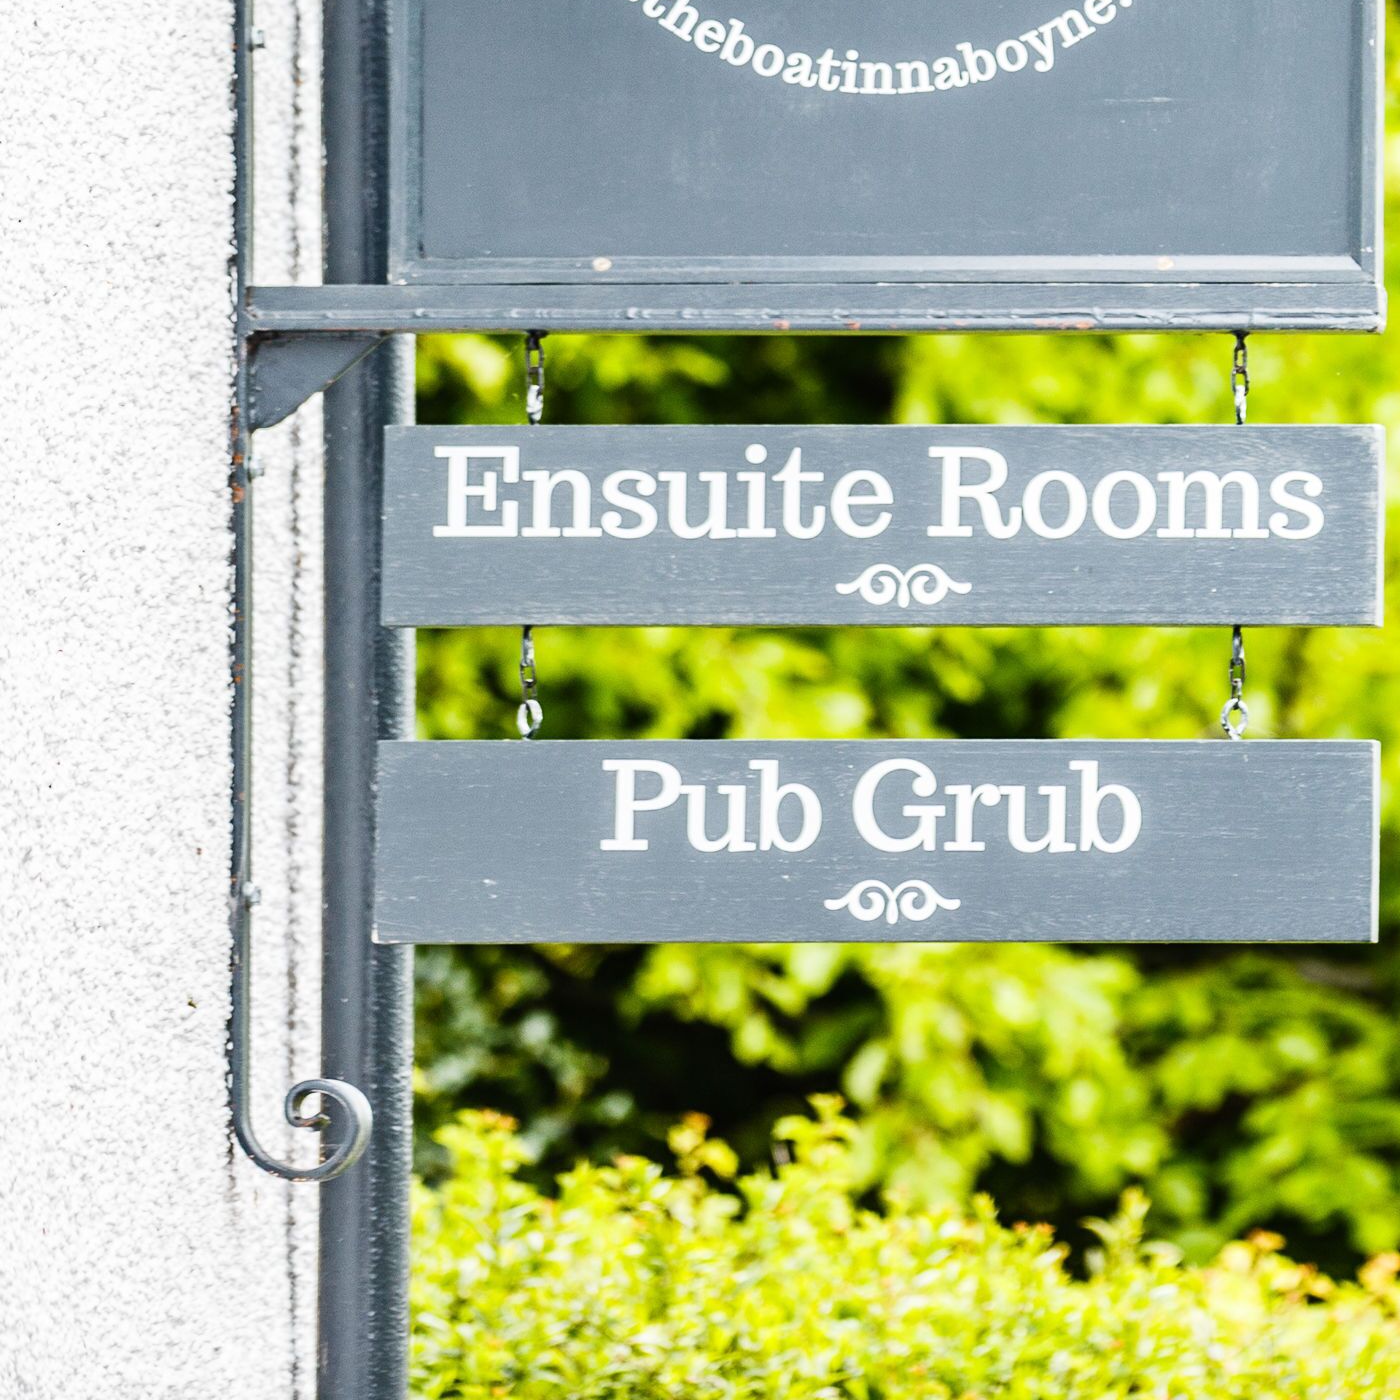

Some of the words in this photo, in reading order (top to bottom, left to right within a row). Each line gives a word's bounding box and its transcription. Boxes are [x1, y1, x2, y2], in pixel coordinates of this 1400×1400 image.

[432, 443, 894, 540] Ensuite
[926, 445, 1325, 540] Rooms
[599, 759, 823, 854] Pub
[852, 757, 1142, 854] Grub
